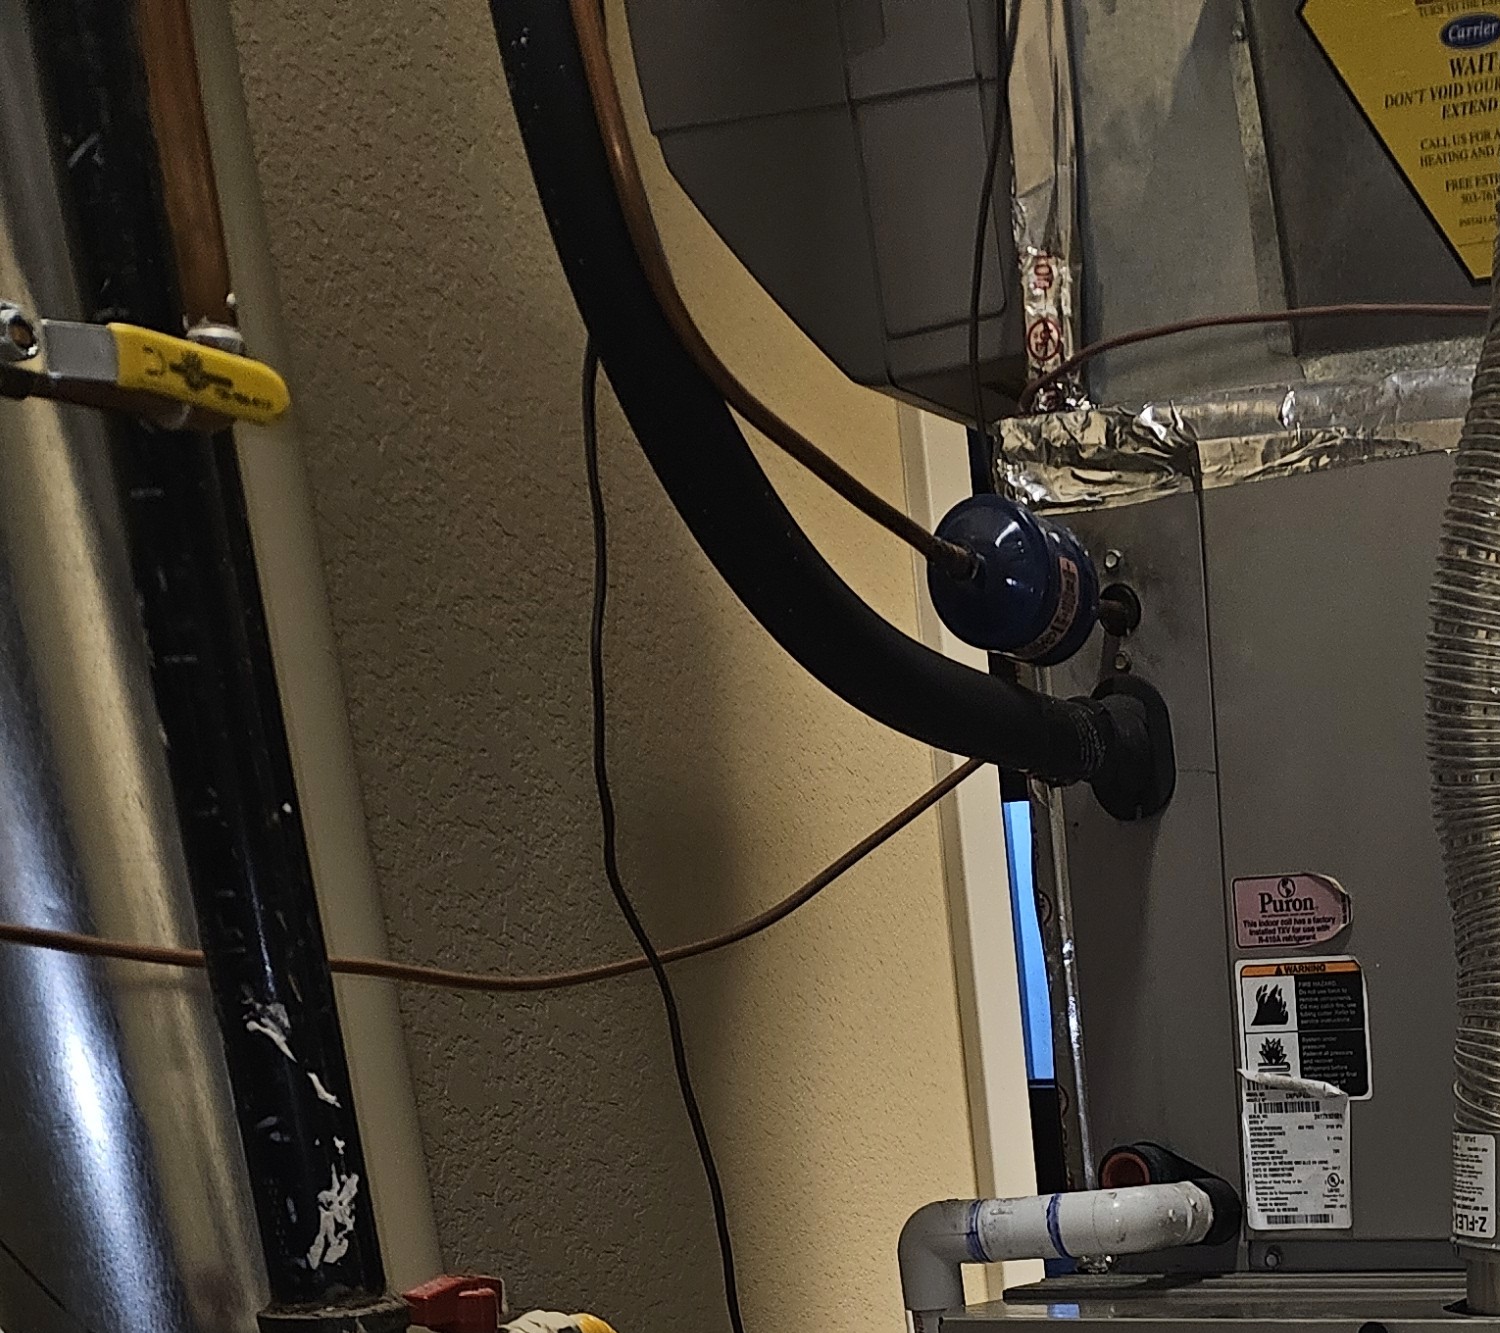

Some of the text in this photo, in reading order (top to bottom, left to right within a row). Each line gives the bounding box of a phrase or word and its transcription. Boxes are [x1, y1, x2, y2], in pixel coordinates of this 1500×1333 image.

[1448, 20, 1498, 41] Carrier
[1384, 88, 1427, 110] DON'T
[1430, 81, 1464, 101] VOID
[1442, 97, 1498, 120] EXTEND
[1452, 134, 1468, 146] US
[1419, 145, 1495, 168] HEATING AND
[1258, 892, 1316, 914] Puron
[1283, 964, 1327, 973] WARNING
